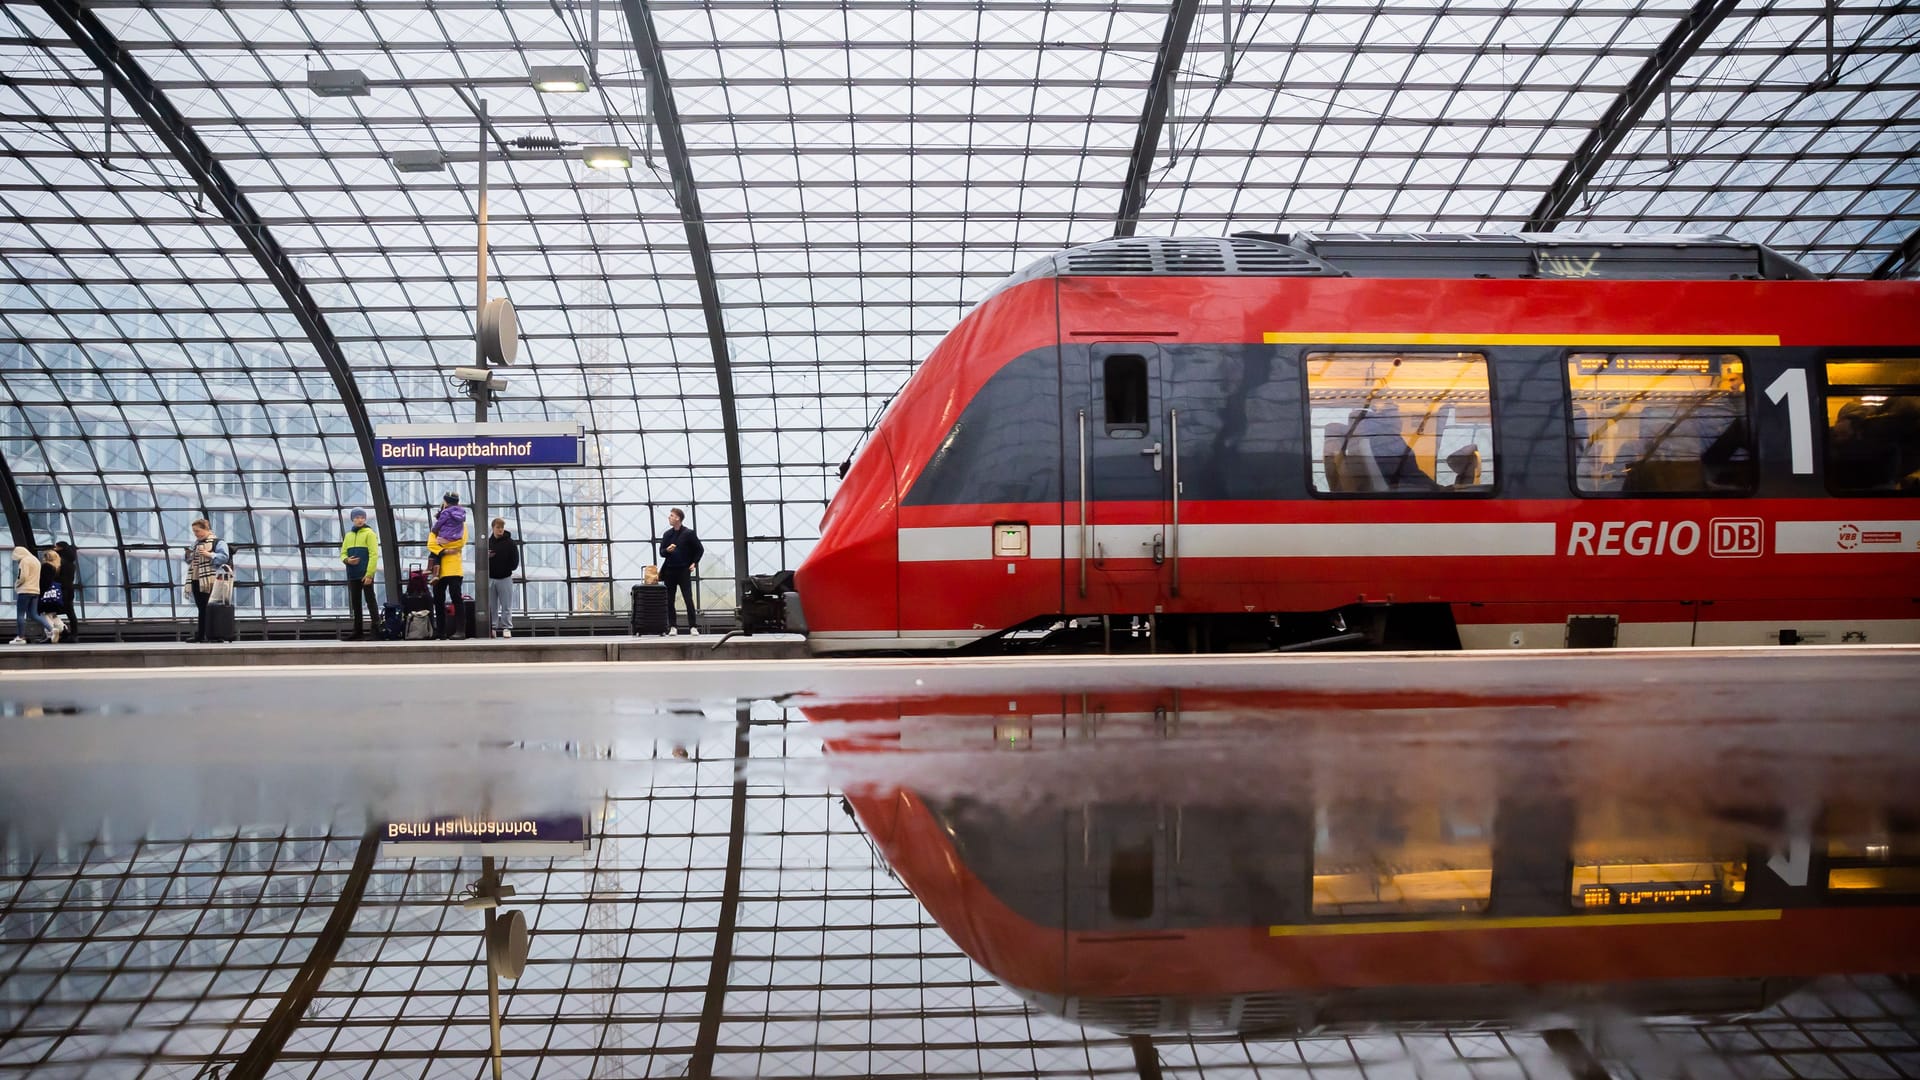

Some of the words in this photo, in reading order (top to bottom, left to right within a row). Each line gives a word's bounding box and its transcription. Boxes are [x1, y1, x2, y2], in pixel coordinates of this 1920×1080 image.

[1764, 368, 1814, 474] 1
[381, 443, 425, 458] Berlin
[429, 441, 532, 460] Hauptbahnhof
[1567, 520, 1700, 556] REGIO
[1715, 523, 1758, 552] DB
[1840, 533, 1857, 541] VBB
